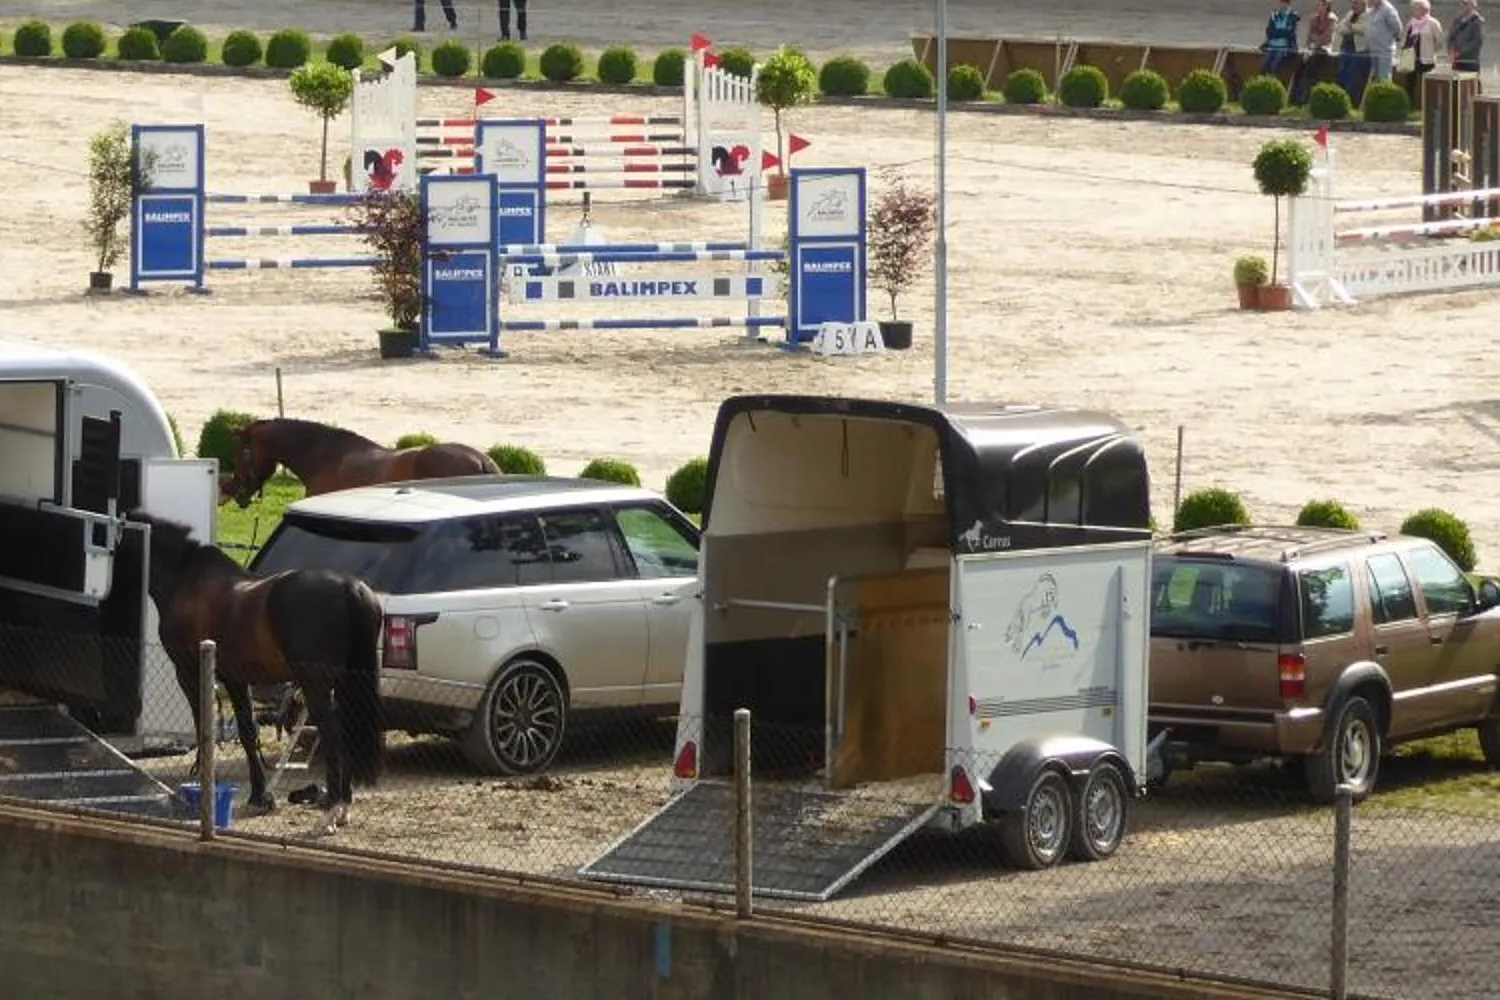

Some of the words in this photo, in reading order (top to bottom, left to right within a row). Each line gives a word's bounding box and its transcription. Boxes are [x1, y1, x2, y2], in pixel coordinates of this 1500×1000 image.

[145, 212, 190, 223] BALIMPEX
[500, 207, 533, 217] LIMPEX
[803, 262, 852, 273] BALIMPEX
[435, 269, 484, 281] BALIMPEX
[590, 281, 698, 297] BALIMPEX
[865, 328, 877, 349] A
